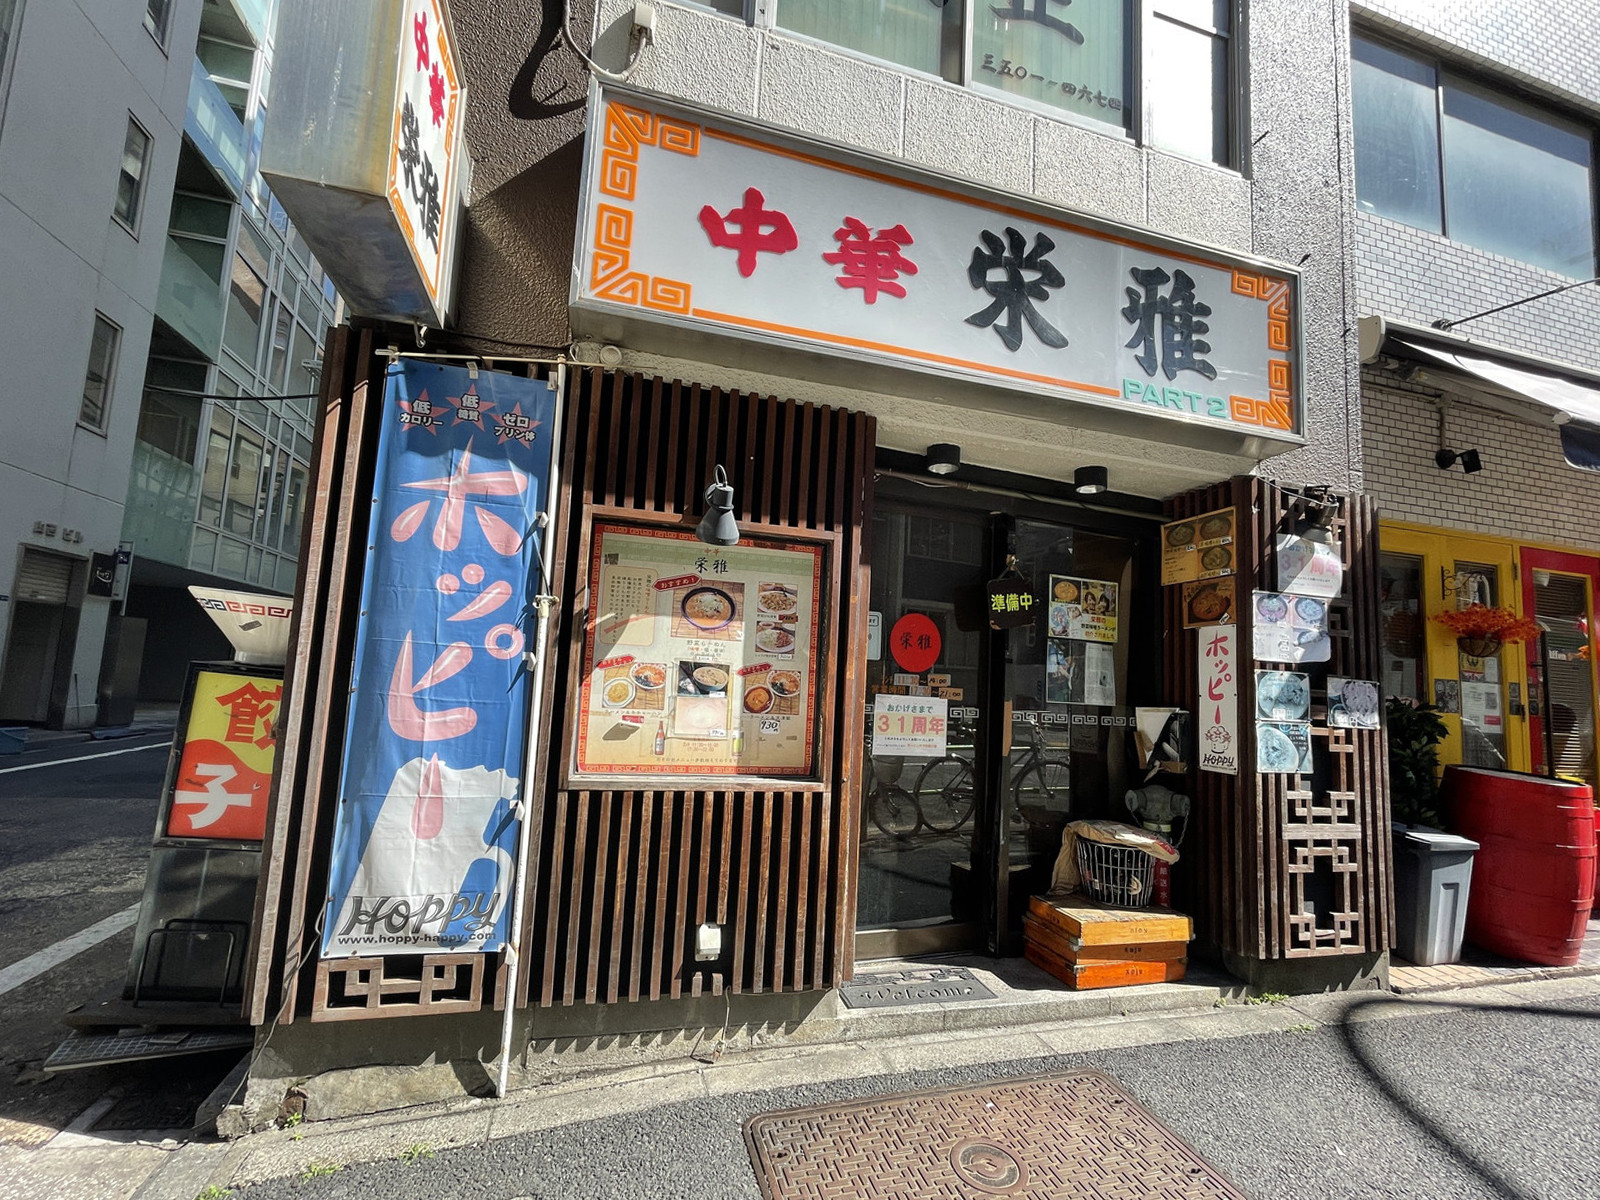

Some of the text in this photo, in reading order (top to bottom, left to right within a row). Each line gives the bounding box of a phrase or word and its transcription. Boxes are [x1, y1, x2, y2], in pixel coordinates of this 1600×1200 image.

[413, 11, 446, 129] 中華
[699, 186, 1219, 381] 中華 栄雅
[461, 394, 480, 409] 低
[1123, 378, 1227, 419] PART 2
[412, 399, 432, 415] 低
[457, 409, 481, 421] 糖質
[400, 413, 443, 427] カロリー
[503, 413, 530, 428] ゼロ
[695, 557, 729, 574] 栄雅
[991, 592, 1033, 612] 準備中
[387, 434, 529, 840] ホッピー
[1206, 631, 1232, 725] ホッピー
[887, 704, 934, 714] おかげさまで
[338, 932, 497, 945] www.hoppy-happy.com
[860, 986, 974, 1001] Welcome
